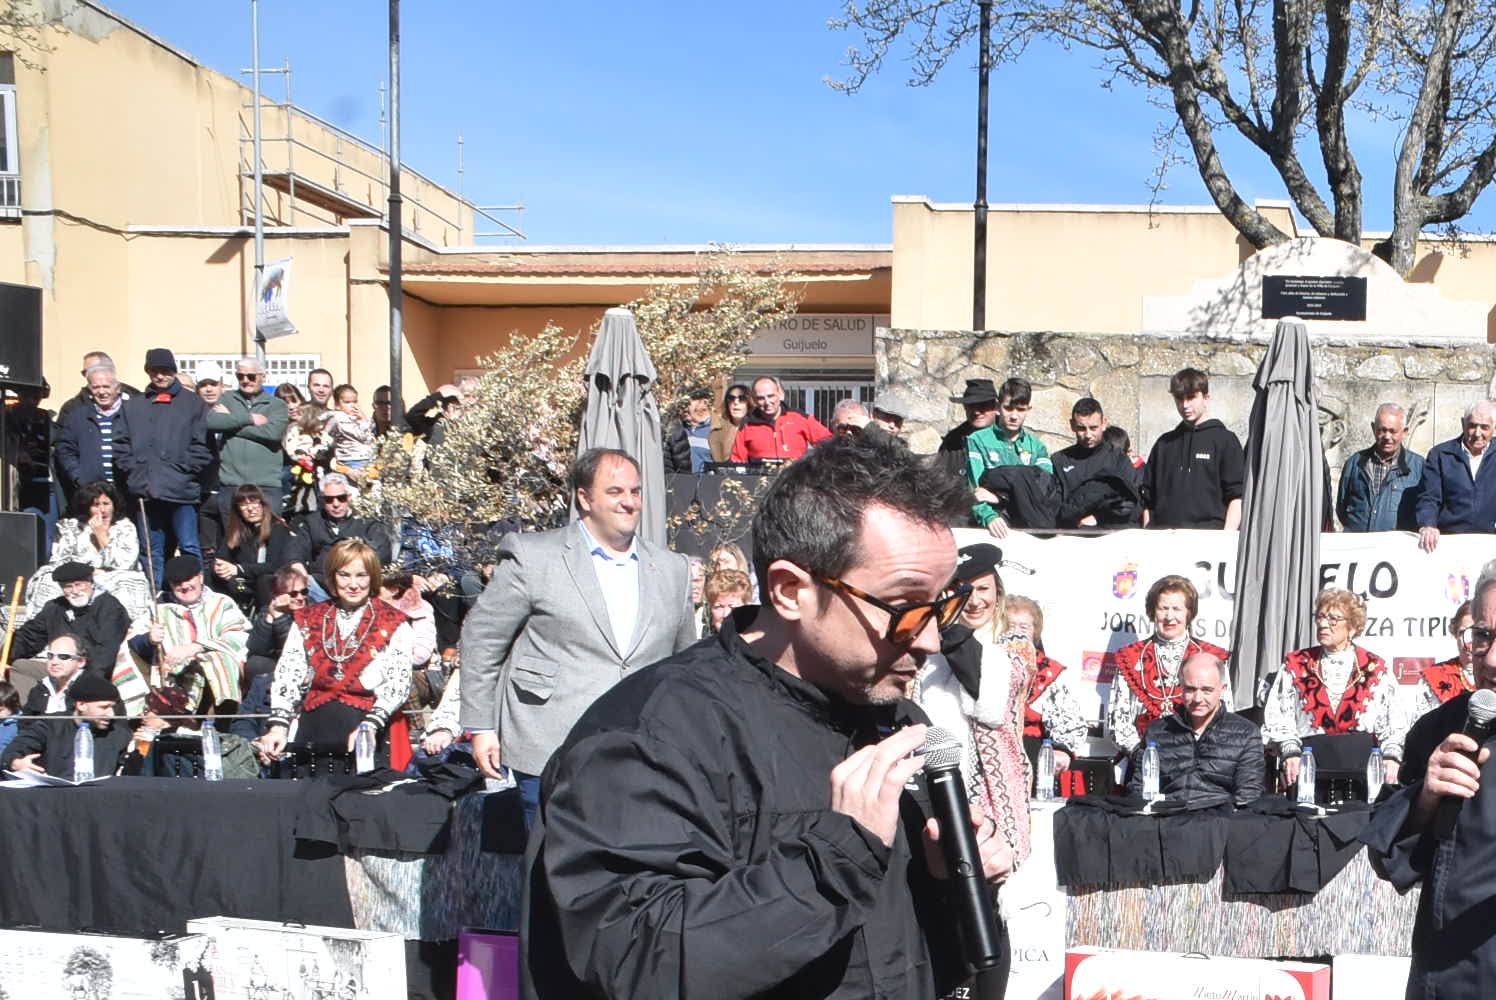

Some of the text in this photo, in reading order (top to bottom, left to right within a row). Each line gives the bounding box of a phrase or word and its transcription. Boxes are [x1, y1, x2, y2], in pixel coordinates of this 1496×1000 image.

[802, 318, 821, 330] DE
[823, 318, 866, 331] SALUD
[783, 338, 828, 352] Guijuelo
